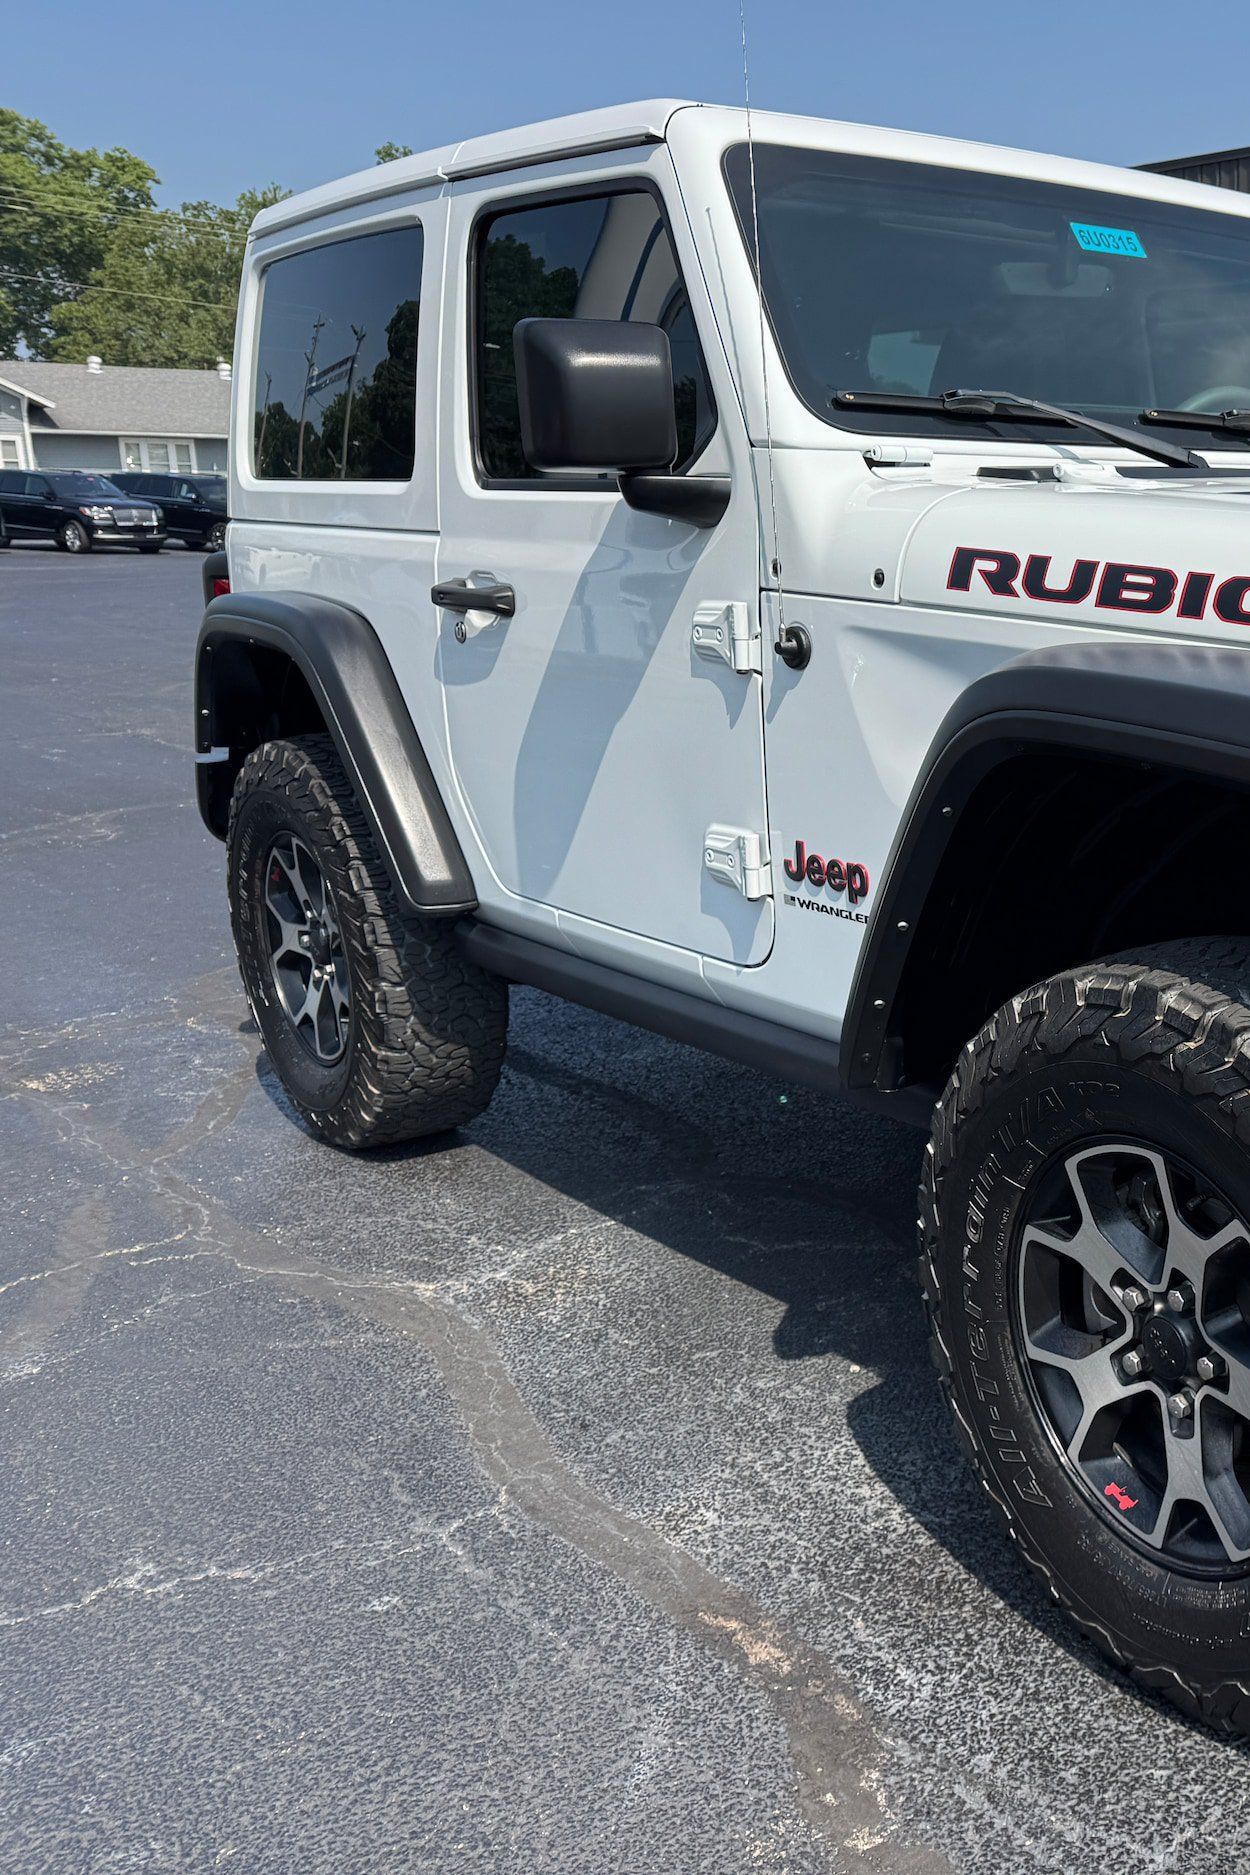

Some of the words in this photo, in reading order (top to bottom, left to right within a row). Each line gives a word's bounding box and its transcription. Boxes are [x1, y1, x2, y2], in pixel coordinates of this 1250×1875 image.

[1079, 229, 1138, 252] 6U0315
[783, 840, 870, 905] Jeep
[961, 1153, 1054, 1508] All-Terrain
